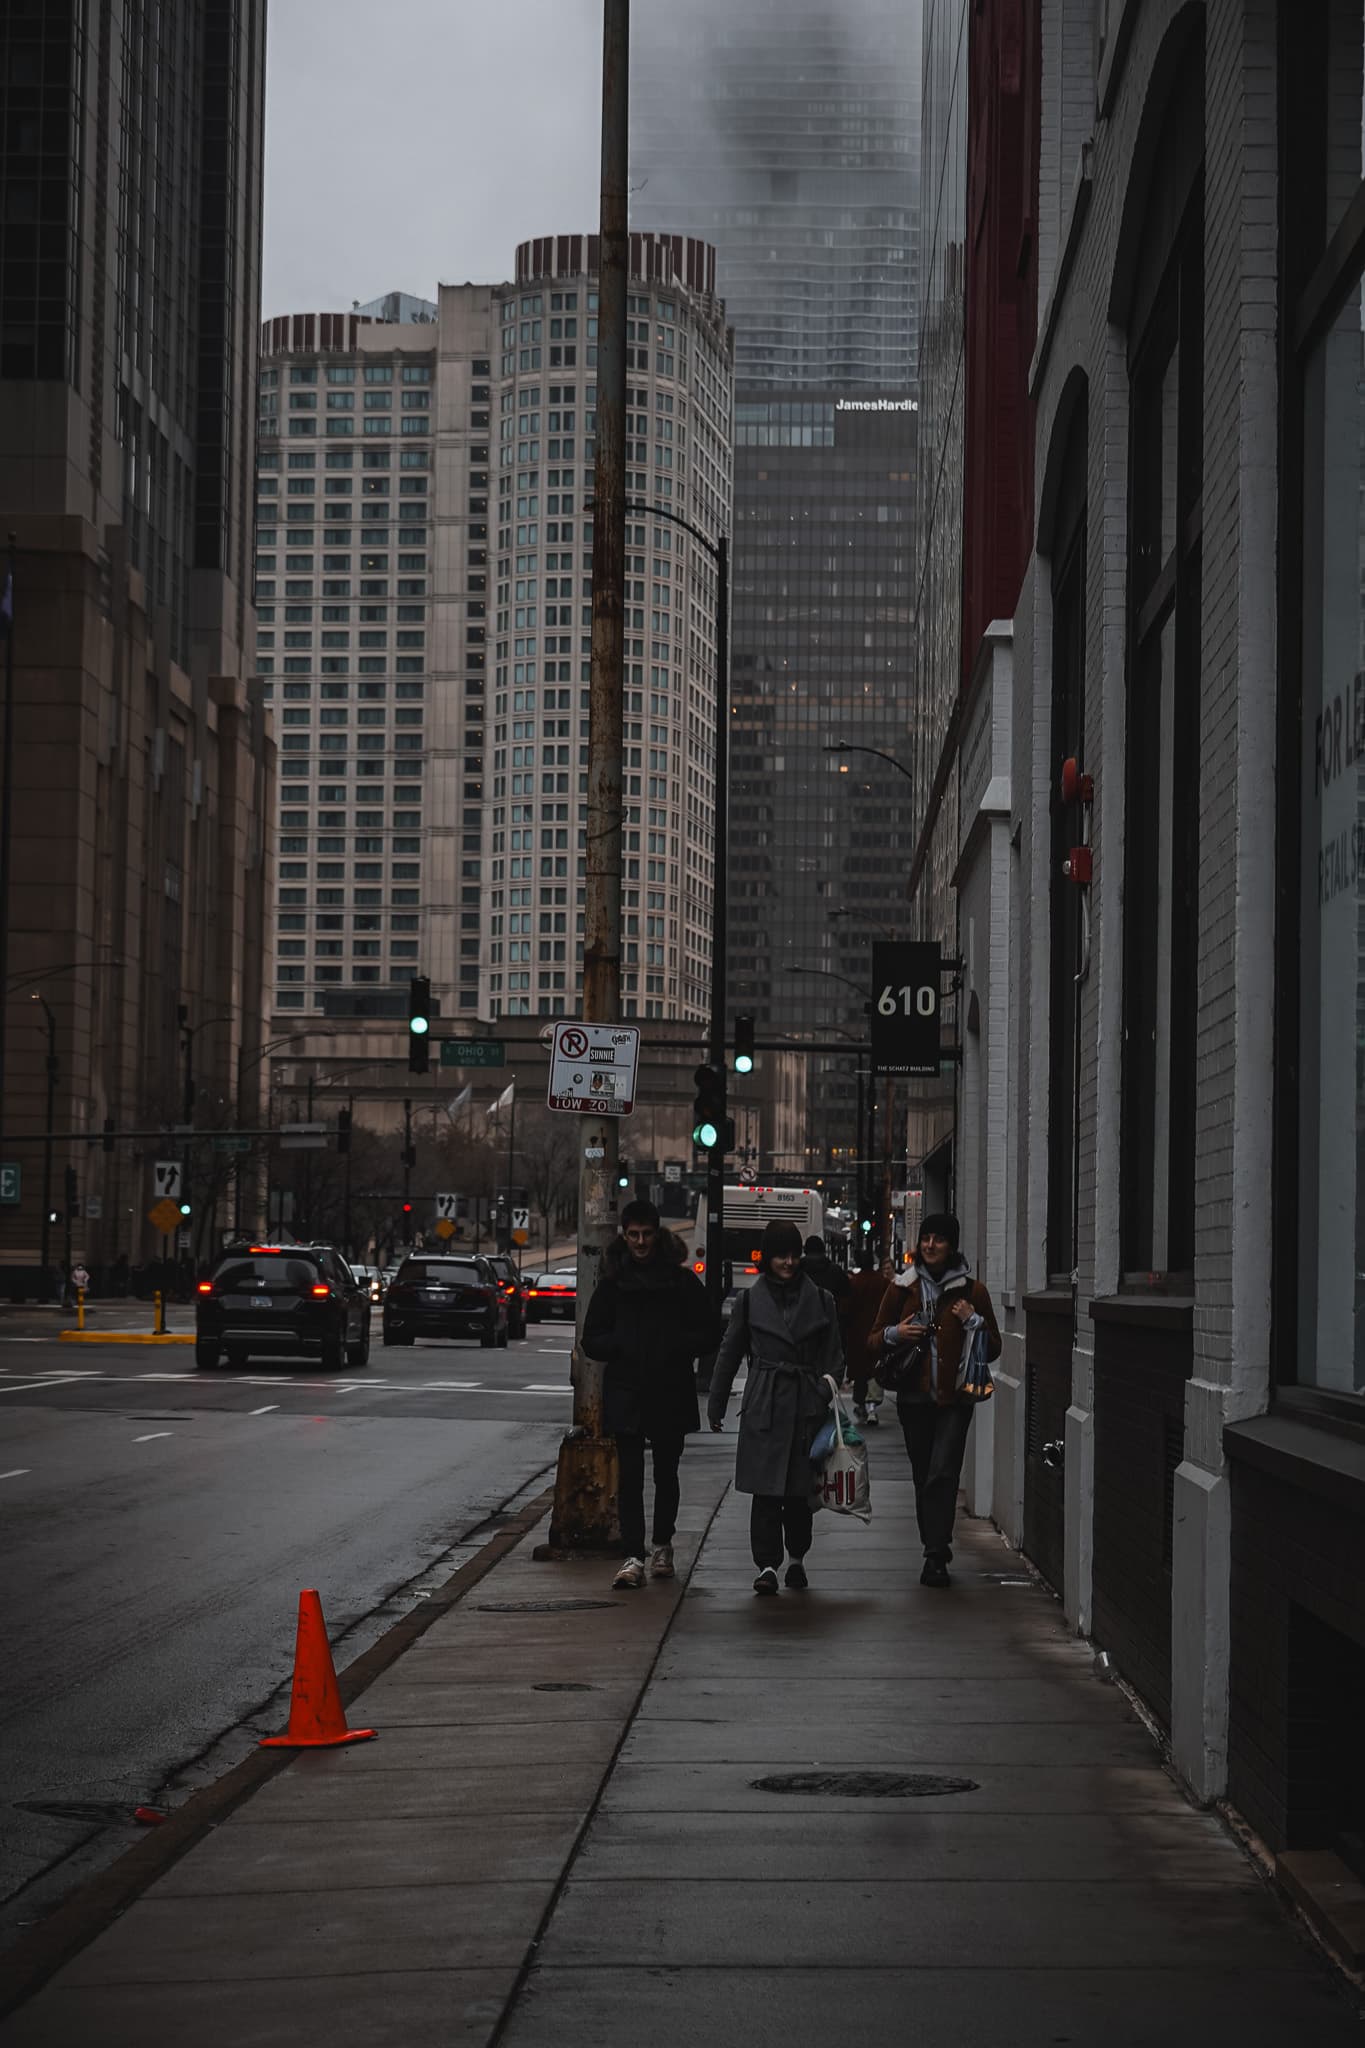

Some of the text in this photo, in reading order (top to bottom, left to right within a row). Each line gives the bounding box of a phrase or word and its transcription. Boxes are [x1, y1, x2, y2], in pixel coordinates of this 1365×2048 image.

[836, 398, 918, 411] JamesHardie
[1315, 694, 1342, 798] FOR
[1318, 829, 1349, 910] RETAIL
[878, 985, 936, 1017] 610
[458, 1046, 484, 1057] OHIO
[590, 1048, 614, 1062] SUNNIE
